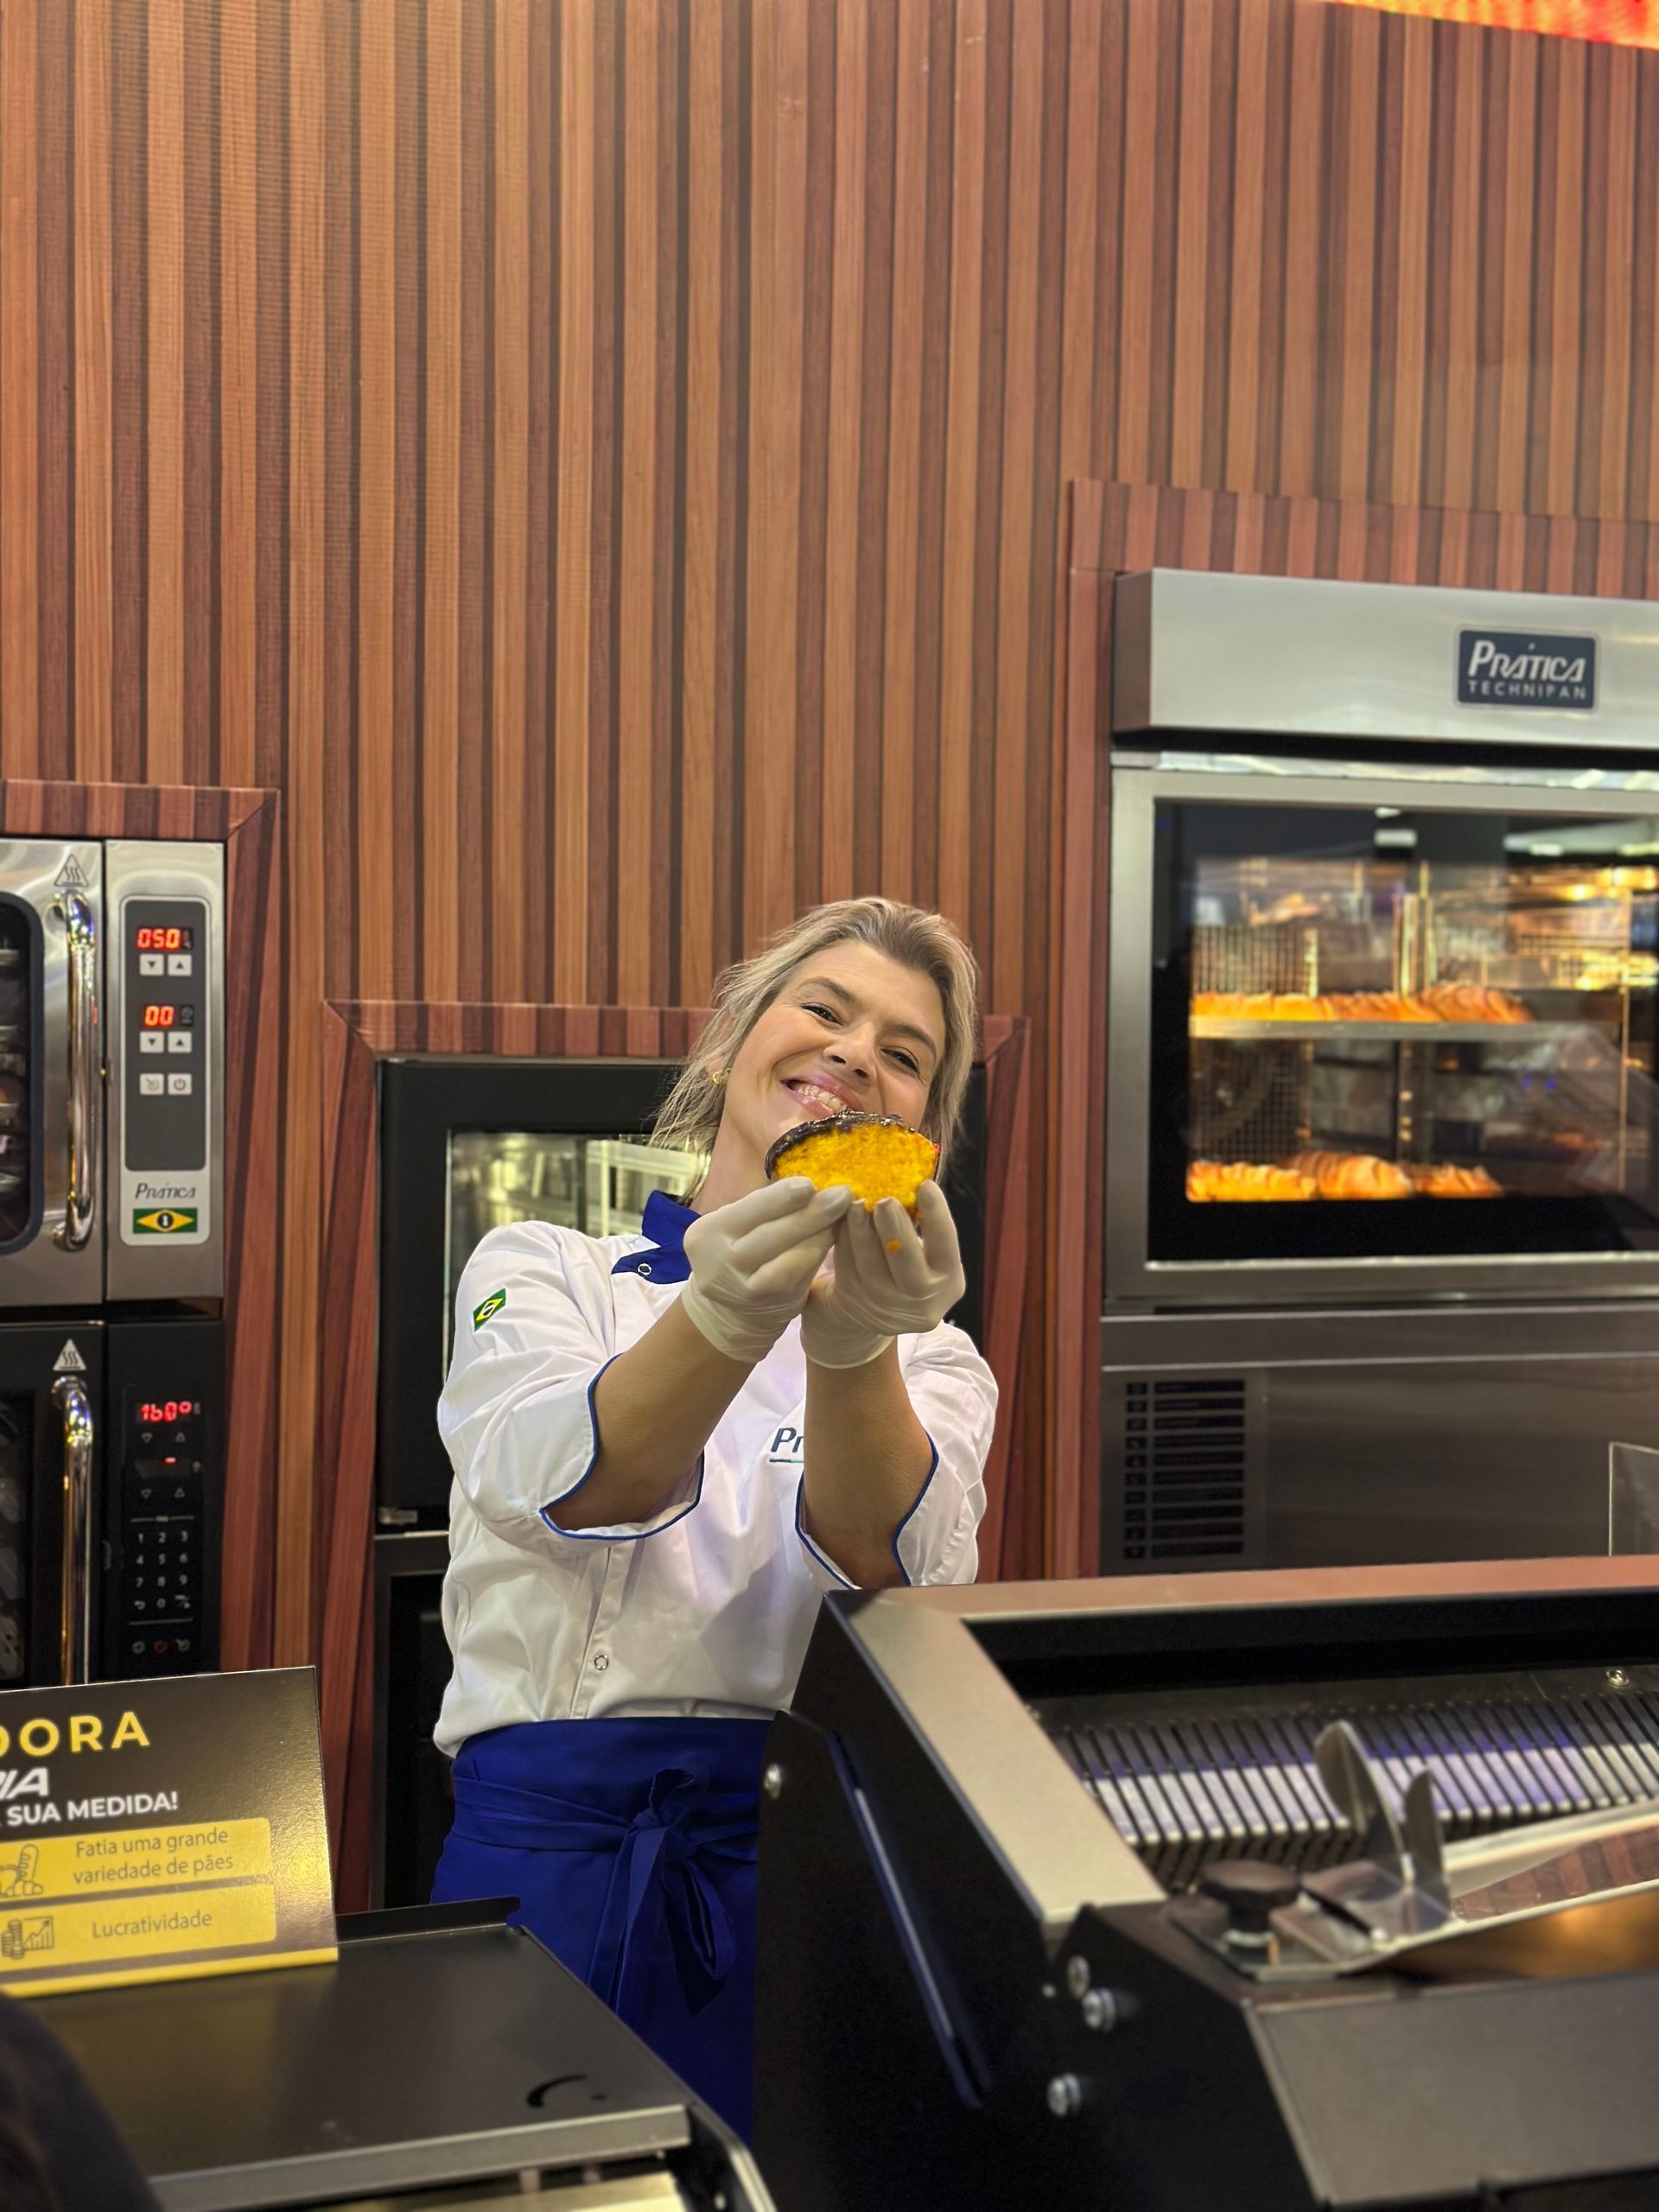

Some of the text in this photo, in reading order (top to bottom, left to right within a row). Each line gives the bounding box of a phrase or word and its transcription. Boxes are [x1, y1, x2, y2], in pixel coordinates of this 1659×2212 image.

[1468, 680, 1587, 701] TECHNIPAN
[137, 928, 181, 949] 050
[144, 1006, 175, 1026] 00
[7, 1791, 179, 1827] SUA MEDIDA!
[76, 1827, 228, 1858] Fatia uma grande
[73, 1855, 233, 1885] variedade de pães
[92, 1909, 213, 1938] Lucratividade
